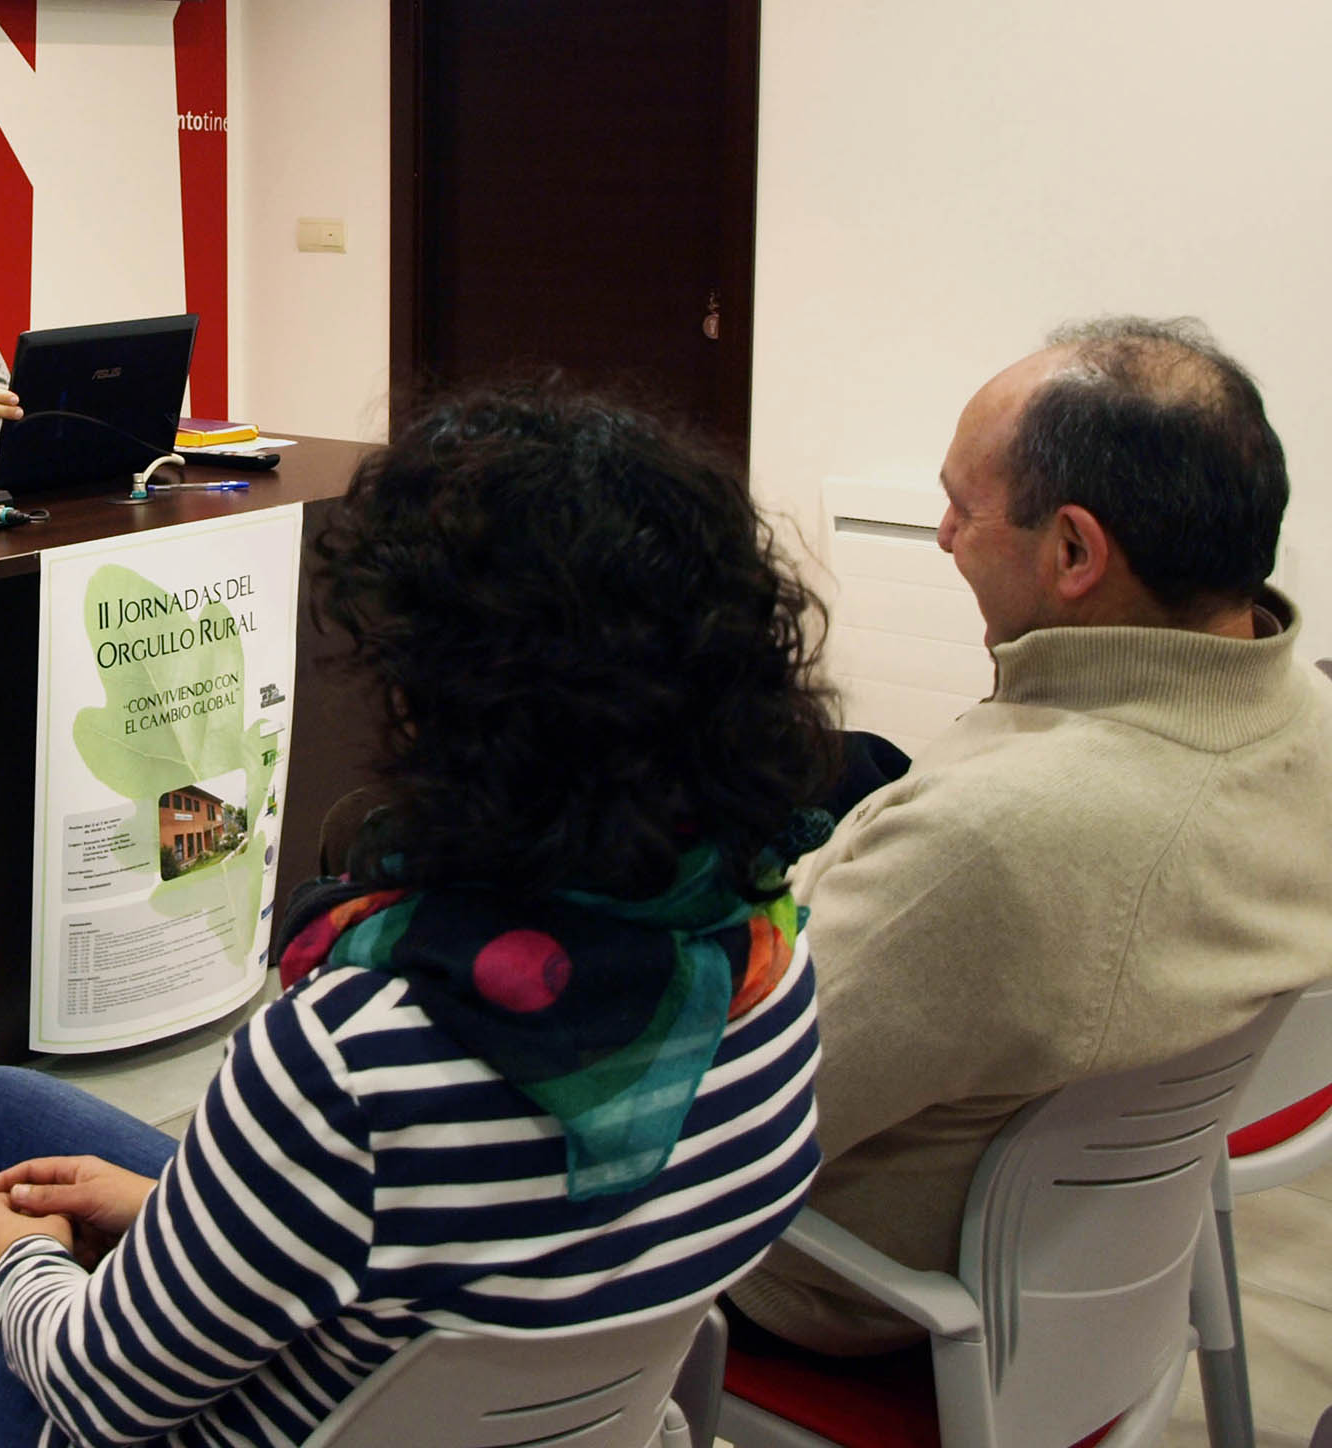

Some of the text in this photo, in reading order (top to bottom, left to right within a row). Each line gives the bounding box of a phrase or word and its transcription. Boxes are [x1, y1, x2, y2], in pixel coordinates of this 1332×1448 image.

[98, 574, 254, 630] II JORNADAS DEL
[97, 611, 257, 669] ORGULLO RURAL
[215, 671, 239, 690] CON
[125, 719, 137, 735] EL
[140, 705, 191, 730] CAMBIO
